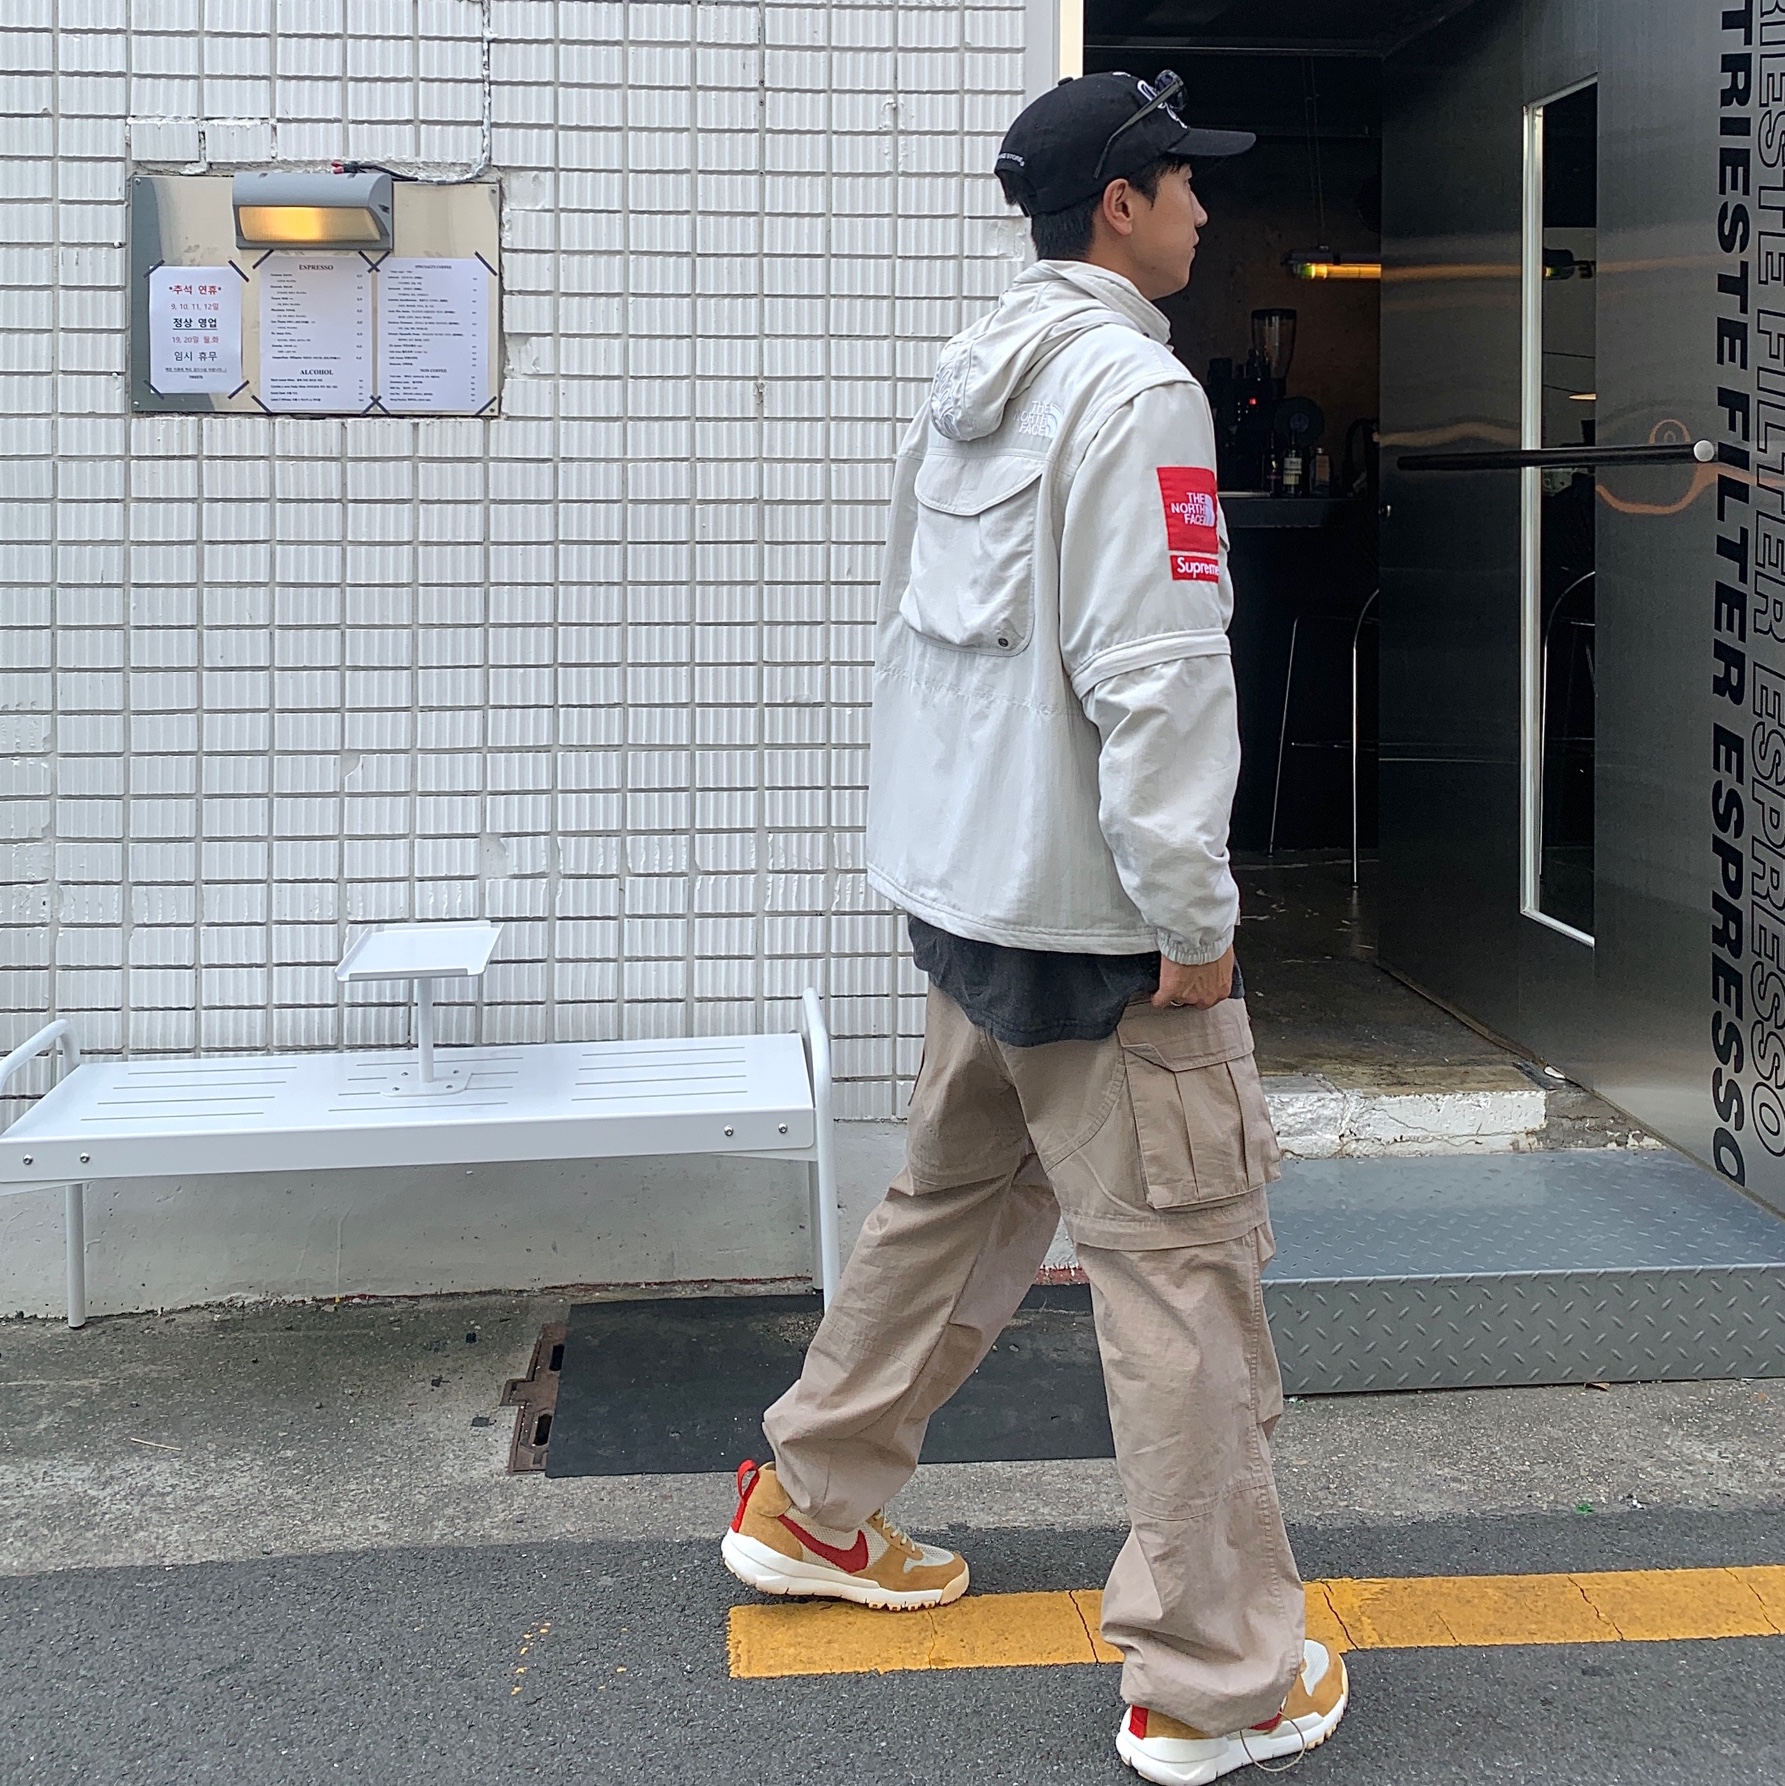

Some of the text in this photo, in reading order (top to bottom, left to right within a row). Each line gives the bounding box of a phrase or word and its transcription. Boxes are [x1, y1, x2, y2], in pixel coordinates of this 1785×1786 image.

[204, 303, 219, 311] 12일
[173, 317, 217, 328] 정상 영업
[183, 336, 199, 344] 20일
[174, 351, 217, 361] 임시 휴무
[1031, 401, 1050, 413] THE
[1019, 422, 1046, 436] FACE
[1754, 308, 1785, 645] FILTER
[1186, 492, 1205, 504] THE
[1171, 502, 1205, 515] NORTH
[1184, 513, 1205, 526] FACE
[1711, 0, 1754, 1187] TRIESTE FILTER ESPRESSO
[1750, 661, 1785, 1157] ESPRESSO
